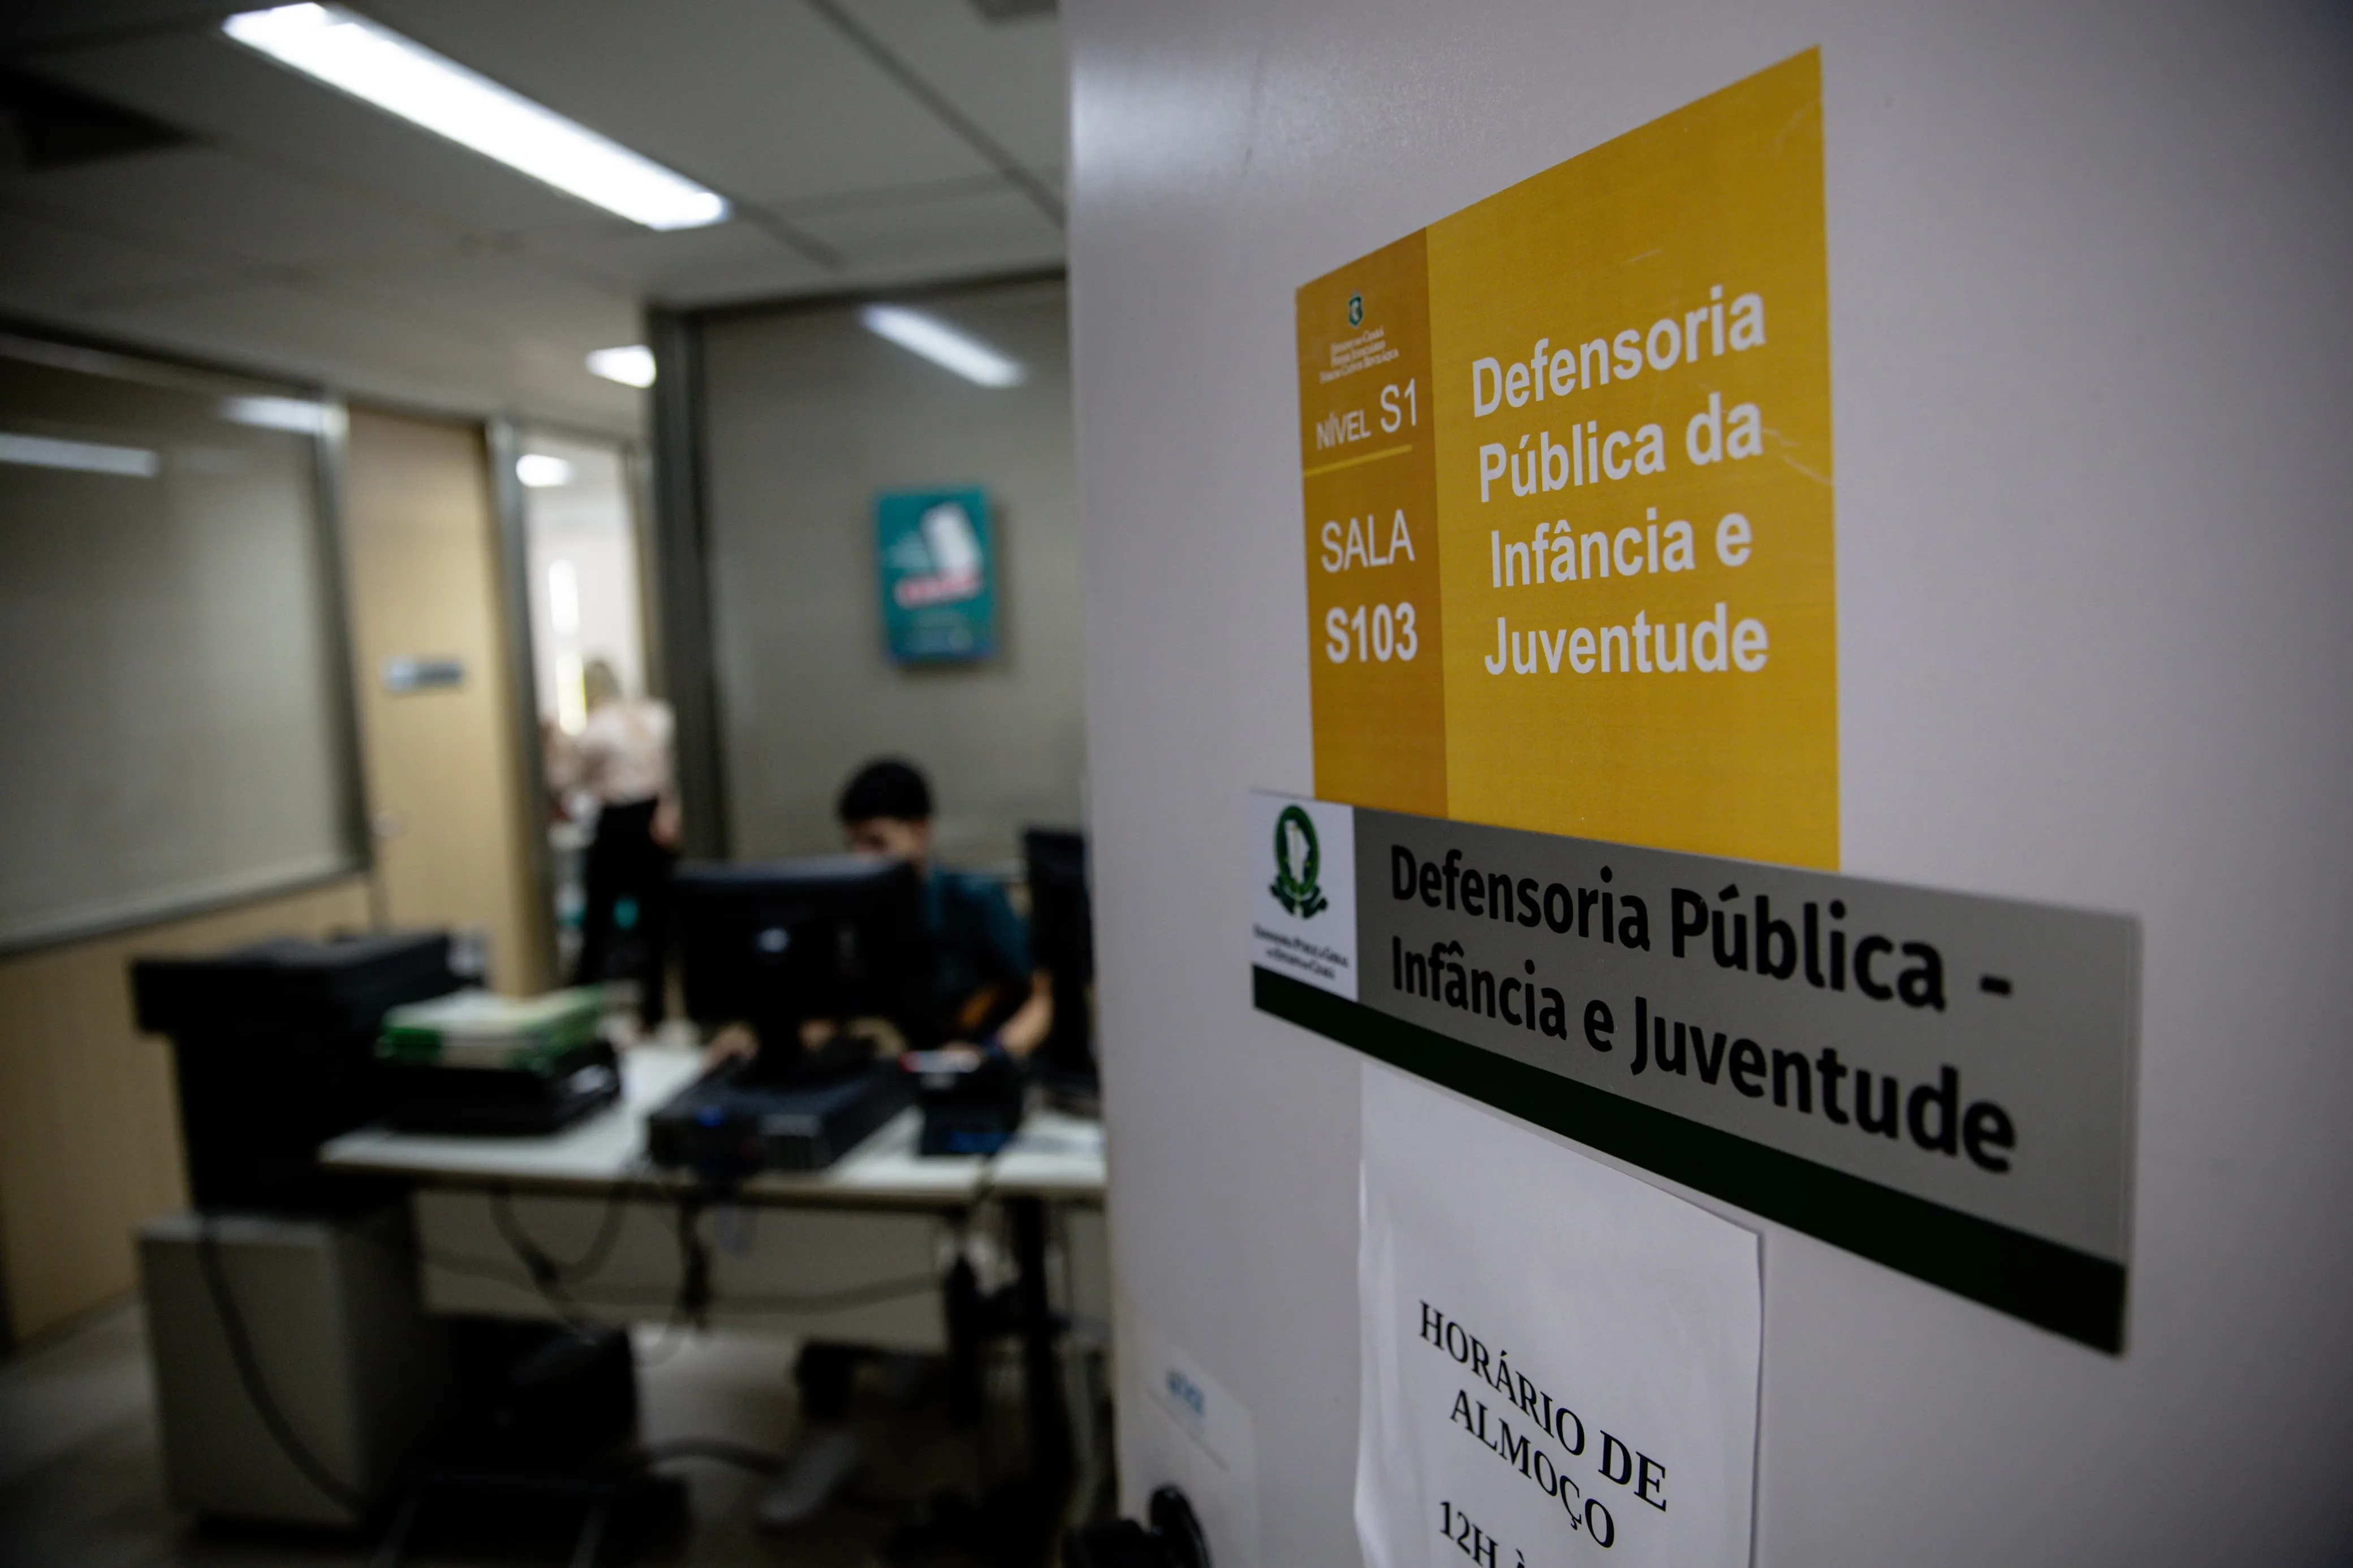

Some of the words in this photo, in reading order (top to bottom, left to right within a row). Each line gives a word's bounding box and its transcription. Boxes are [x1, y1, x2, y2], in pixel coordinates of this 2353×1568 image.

[1472, 284, 1766, 417] Defensoria
[1316, 409, 1371, 451] NÍVEL
[1380, 377, 1416, 433] S1
[1479, 420, 1666, 503] Pública
[1686, 391, 1763, 465] da
[1321, 509, 1415, 573] SALA
[1491, 507, 1695, 588] Infância
[1715, 512, 1752, 567] e
[1325, 602, 1417, 664] S103
[1484, 602, 1769, 675] Juventude
[1391, 844, 1650, 952] Defensoria
[1671, 883, 1946, 1012] Pública
[1393, 935, 1567, 1040] Infância
[1584, 1000, 1614, 1052] e
[1630, 996, 2015, 1173] Juventude
[1419, 1301, 1585, 1456] HORÁRIO
[1598, 1430, 1667, 1512] DE
[1450, 1389, 1615, 1549] ALMOÇO
[1440, 1501, 1499, 1568] 12H
